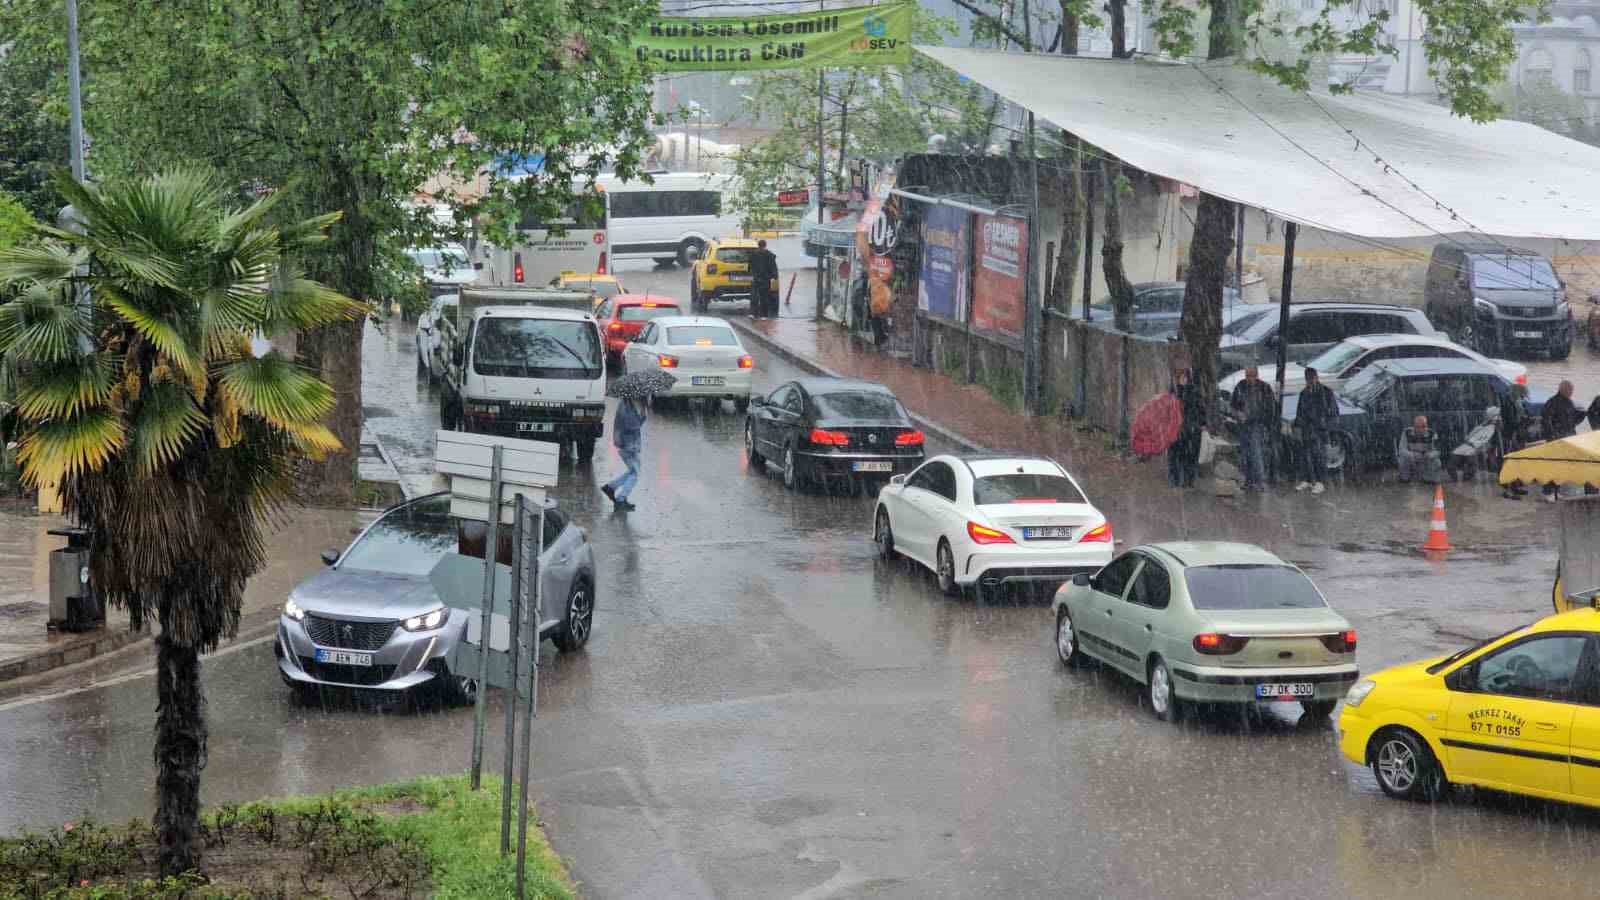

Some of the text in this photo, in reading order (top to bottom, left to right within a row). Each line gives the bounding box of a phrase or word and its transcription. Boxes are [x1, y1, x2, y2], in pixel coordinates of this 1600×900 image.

[1295, 683, 1312, 694] 300
[1471, 722, 1521, 737] 67 T 0155
